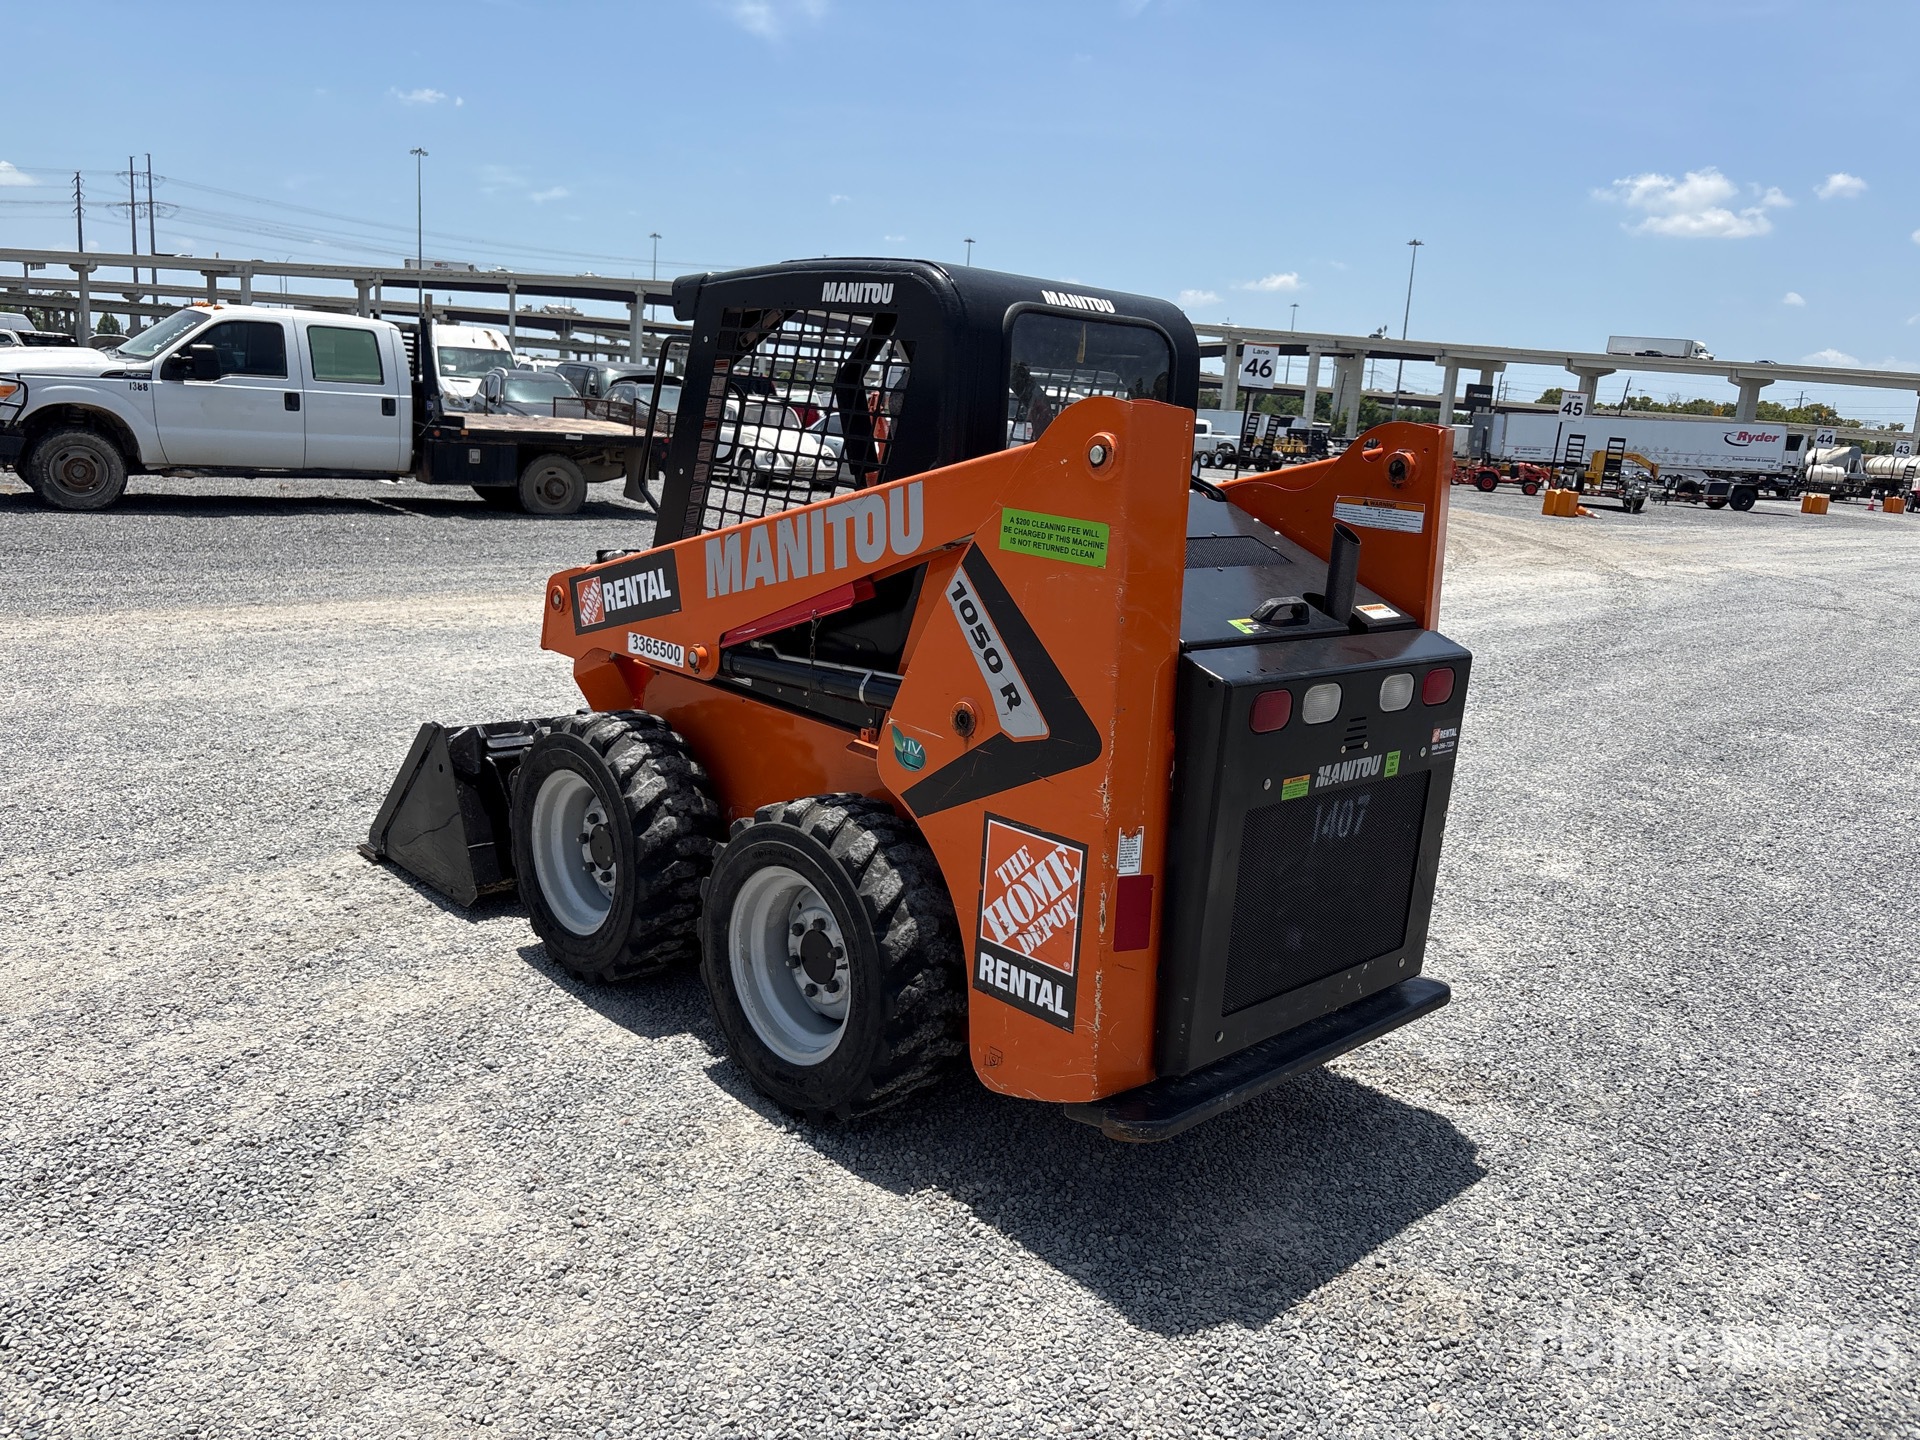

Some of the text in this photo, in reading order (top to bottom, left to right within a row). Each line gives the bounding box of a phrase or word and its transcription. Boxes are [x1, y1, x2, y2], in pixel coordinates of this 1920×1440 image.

[821, 282, 894, 304] MANITOU
[1041, 290, 1115, 313] MANITOU
[1244, 358, 1273, 378] 46
[129, 381, 148, 391] 1388
[1561, 401, 1583, 416] 45
[1736, 431, 1780, 443] Ryder
[1817, 434, 1833, 444] 44
[1896, 446, 1910, 454] 43
[705, 480, 924, 599] MANITOU
[1003, 525, 1012, 533] BE
[1013, 527, 1047, 540] CHARGED
[1056, 534, 1071, 543] THIS
[1072, 537, 1105, 550] MACHINE
[1016, 517, 1030, 526] $200
[1031, 520, 1066, 532] CLEANING
[1067, 526, 1081, 535] FEE
[1082, 529, 1100, 538] WILL
[1018, 539, 1032, 547] NOT
[1033, 541, 1069, 555] RETURNED
[1070, 547, 1095, 559] CLEAN
[602, 568, 671, 613] RENTAL
[632, 634, 681, 662] 3365500
[951, 580, 1022, 712] 1050 R
[1440, 728, 1457, 739] RENTAL
[1315, 754, 1383, 788] MANITOU
[1312, 794, 1371, 843] 1407
[994, 844, 1035, 887] THE
[983, 844, 1081, 945] HOME
[1016, 894, 1077, 956] DEPOT
[979, 952, 1069, 1018] RENTAL
